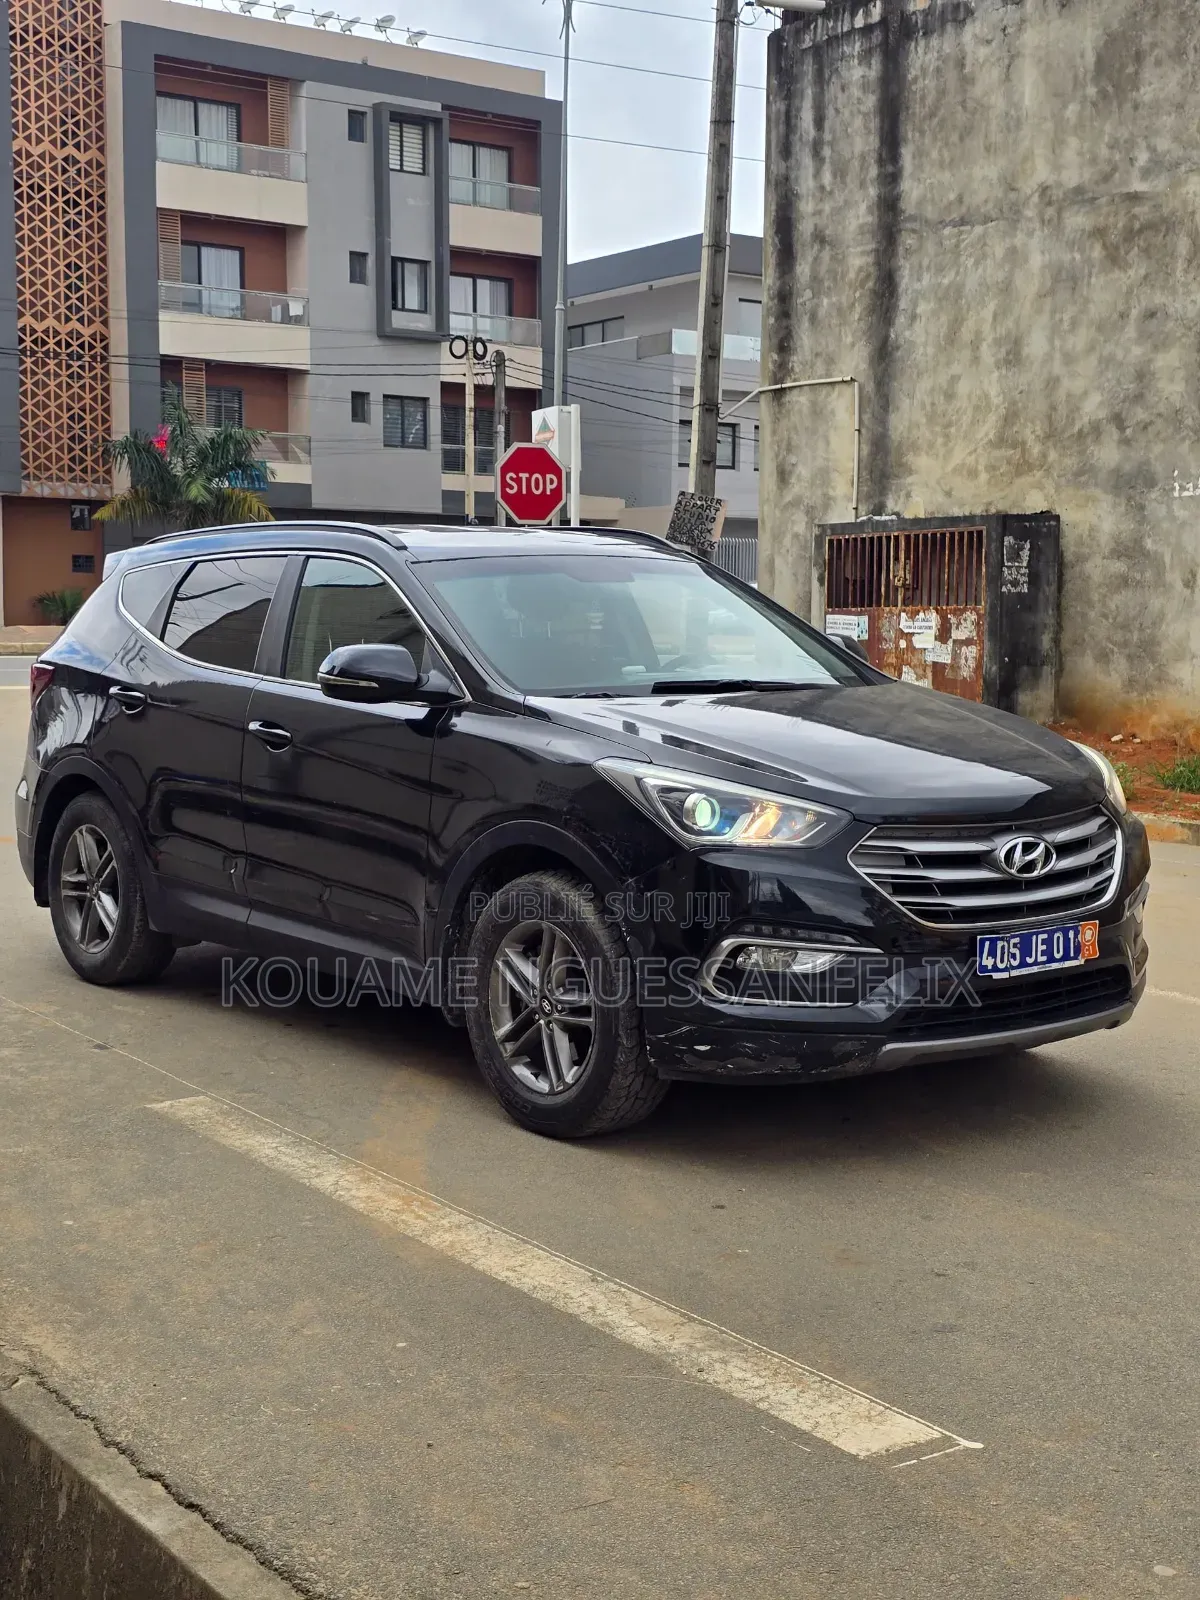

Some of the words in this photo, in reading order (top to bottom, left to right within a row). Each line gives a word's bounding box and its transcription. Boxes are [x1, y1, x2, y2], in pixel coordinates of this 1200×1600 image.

[505, 472, 558, 495] STOP
[675, 500, 721, 515] APPART
[690, 493, 723, 507] LOUER
[674, 506, 717, 524] STUDIO
[981, 937, 1021, 970] 405
[1026, 933, 1048, 964] JE
[1053, 929, 1076, 960] 01
